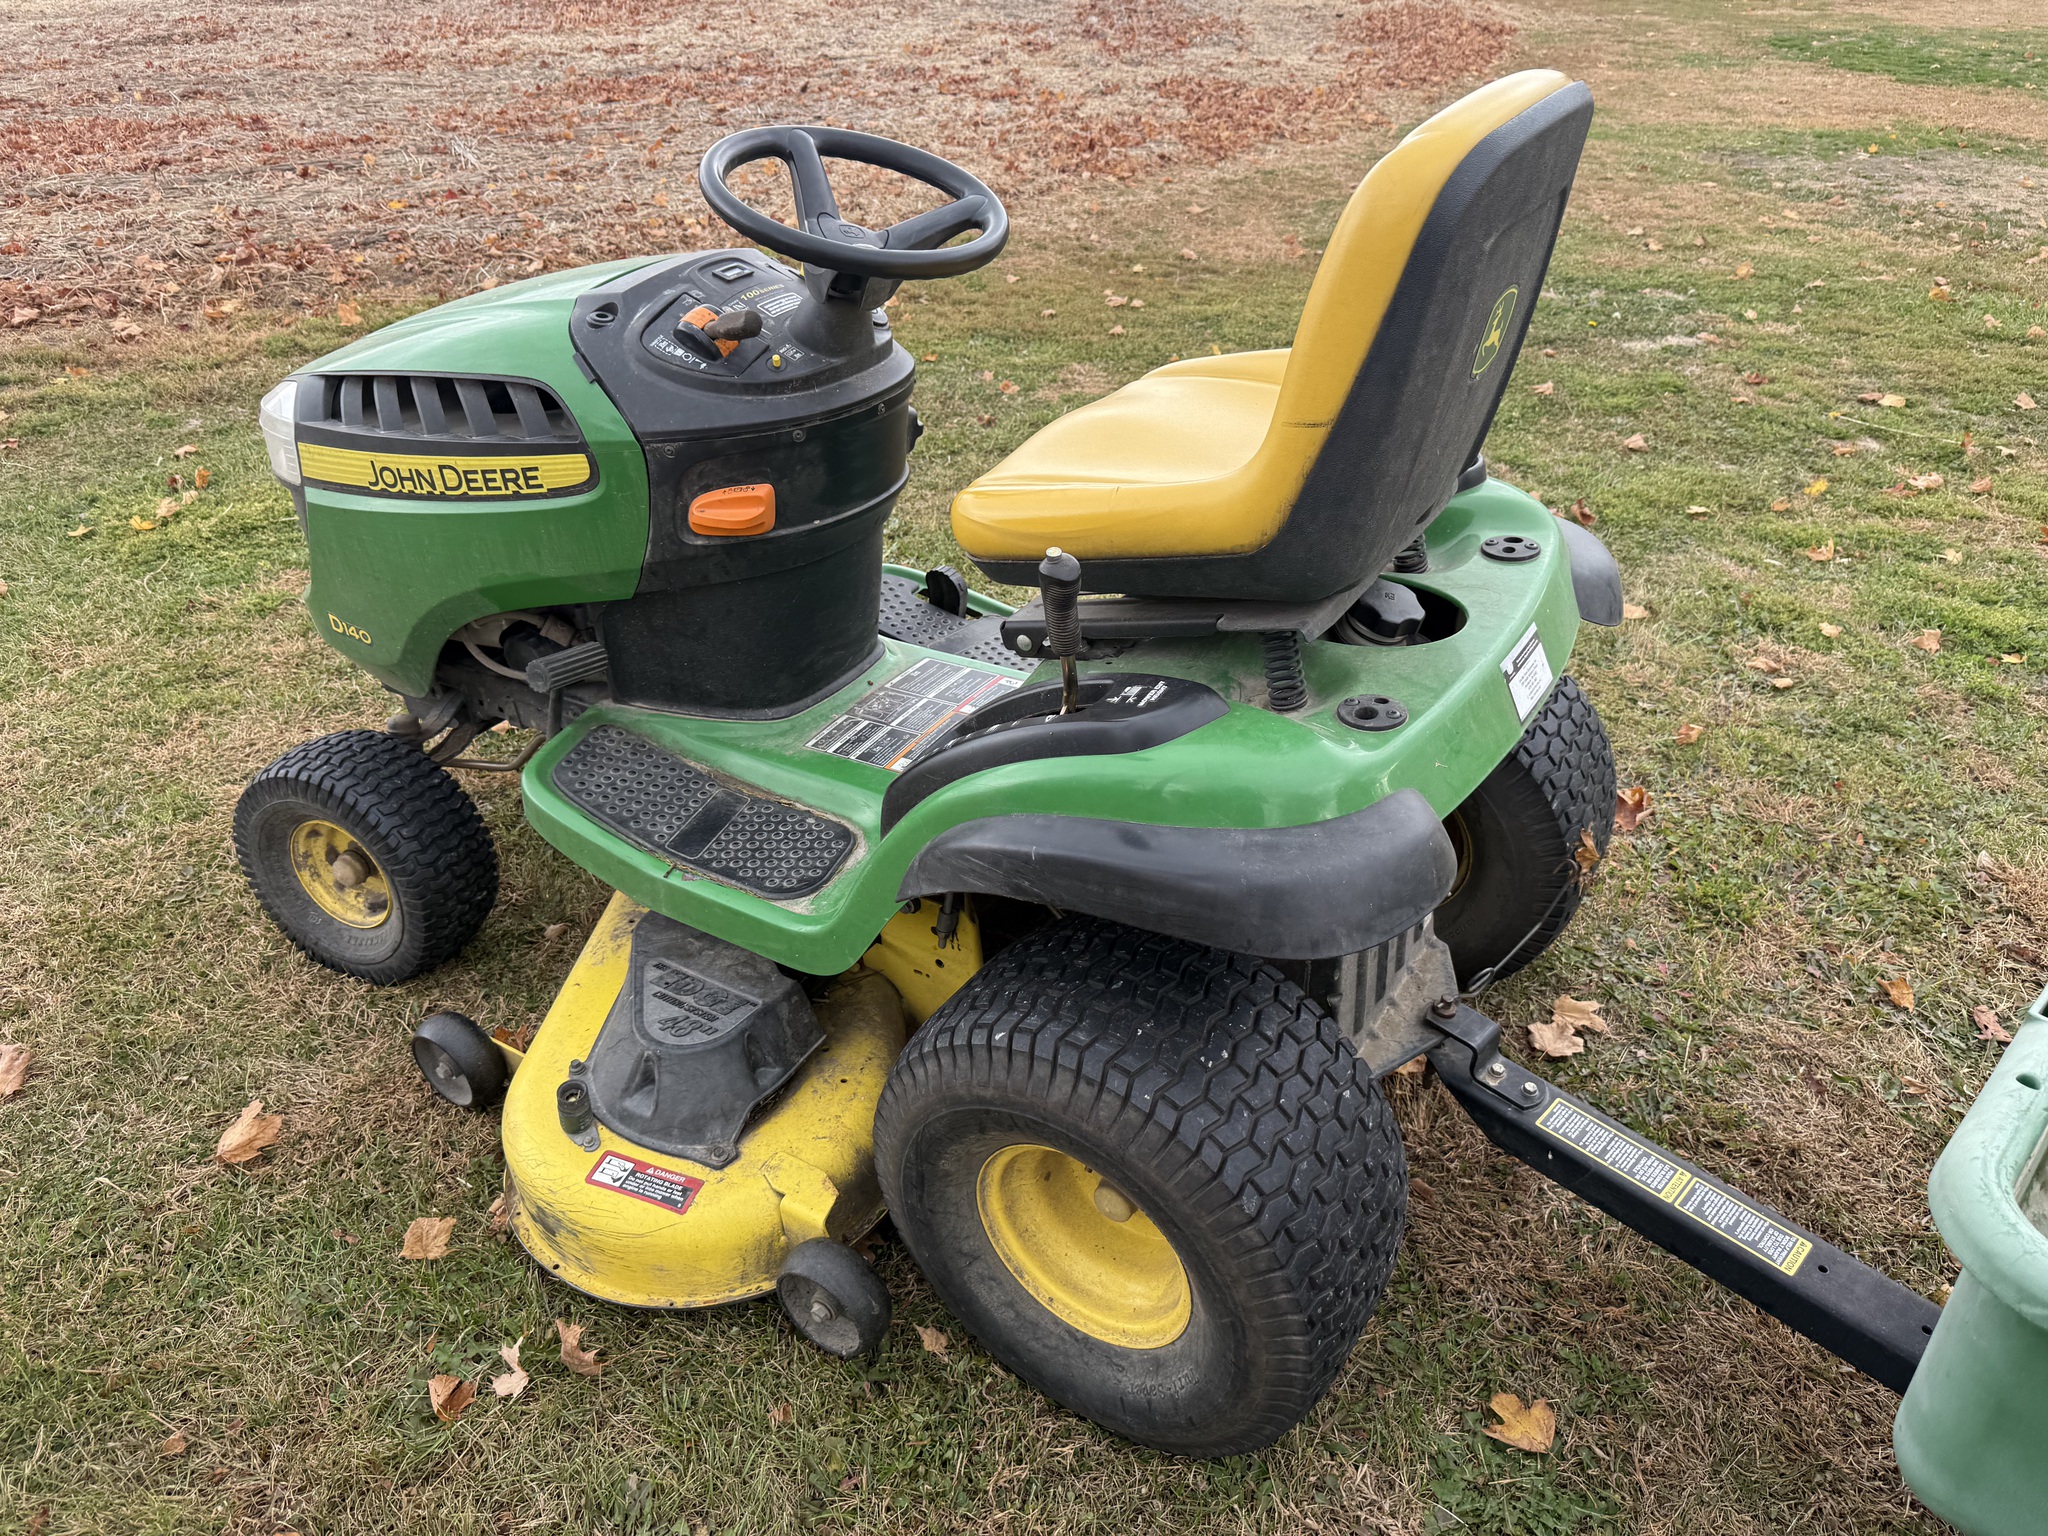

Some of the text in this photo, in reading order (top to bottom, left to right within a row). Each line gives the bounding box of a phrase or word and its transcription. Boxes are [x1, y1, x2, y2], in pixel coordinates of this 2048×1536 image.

[368, 460, 545, 493] JOHN DEERE
[328, 612, 372, 645] D140
[636, 1172, 683, 1191] ROTATING BLADE
[654, 1169, 685, 1183] DANGER
[1662, 1176, 1682, 1199] ATTENTION
[1783, 1245, 1805, 1272] CAUTION
